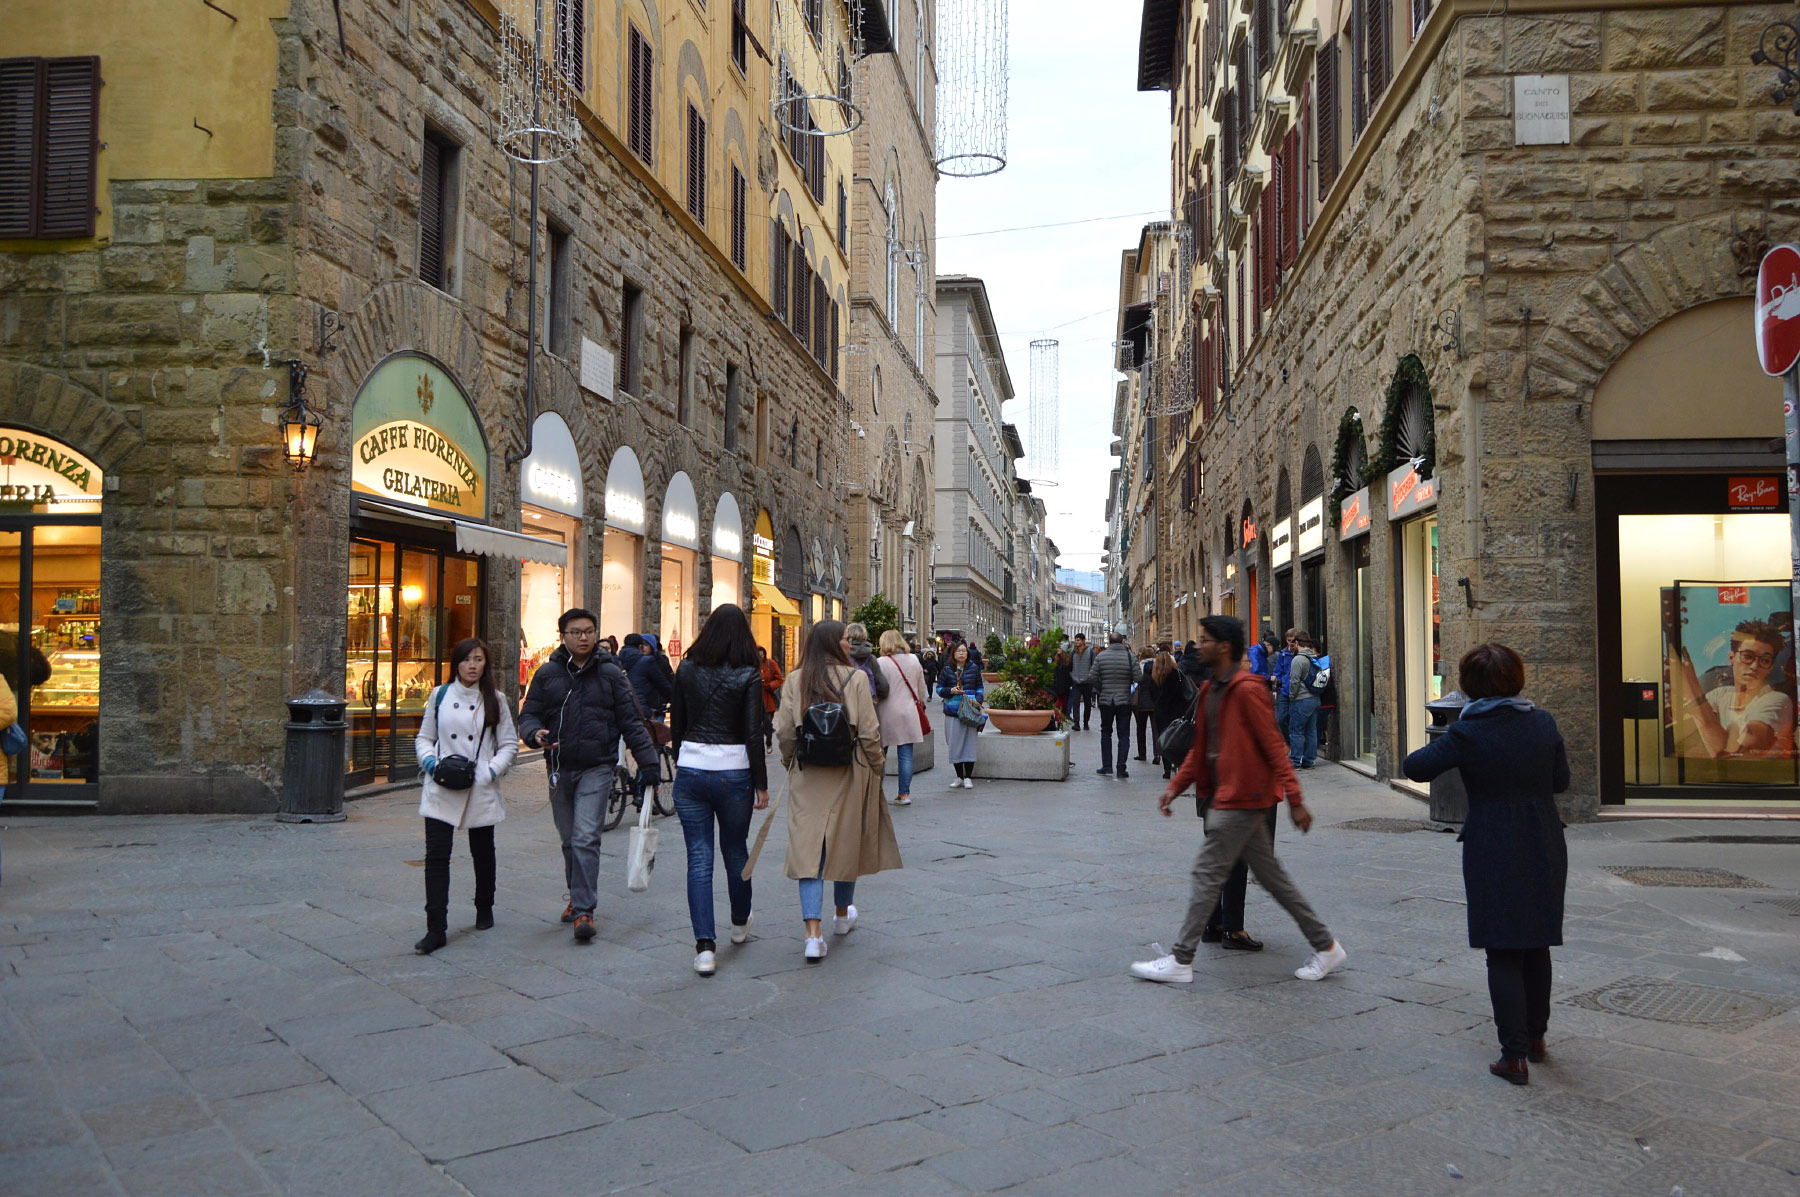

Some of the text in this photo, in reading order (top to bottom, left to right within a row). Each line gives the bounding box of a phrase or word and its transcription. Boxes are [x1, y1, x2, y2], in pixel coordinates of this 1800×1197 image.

[1523, 88, 1560, 96] CANTO
[413, 426, 479, 497] FIORENZA
[383, 468, 461, 506] GELATERIA
